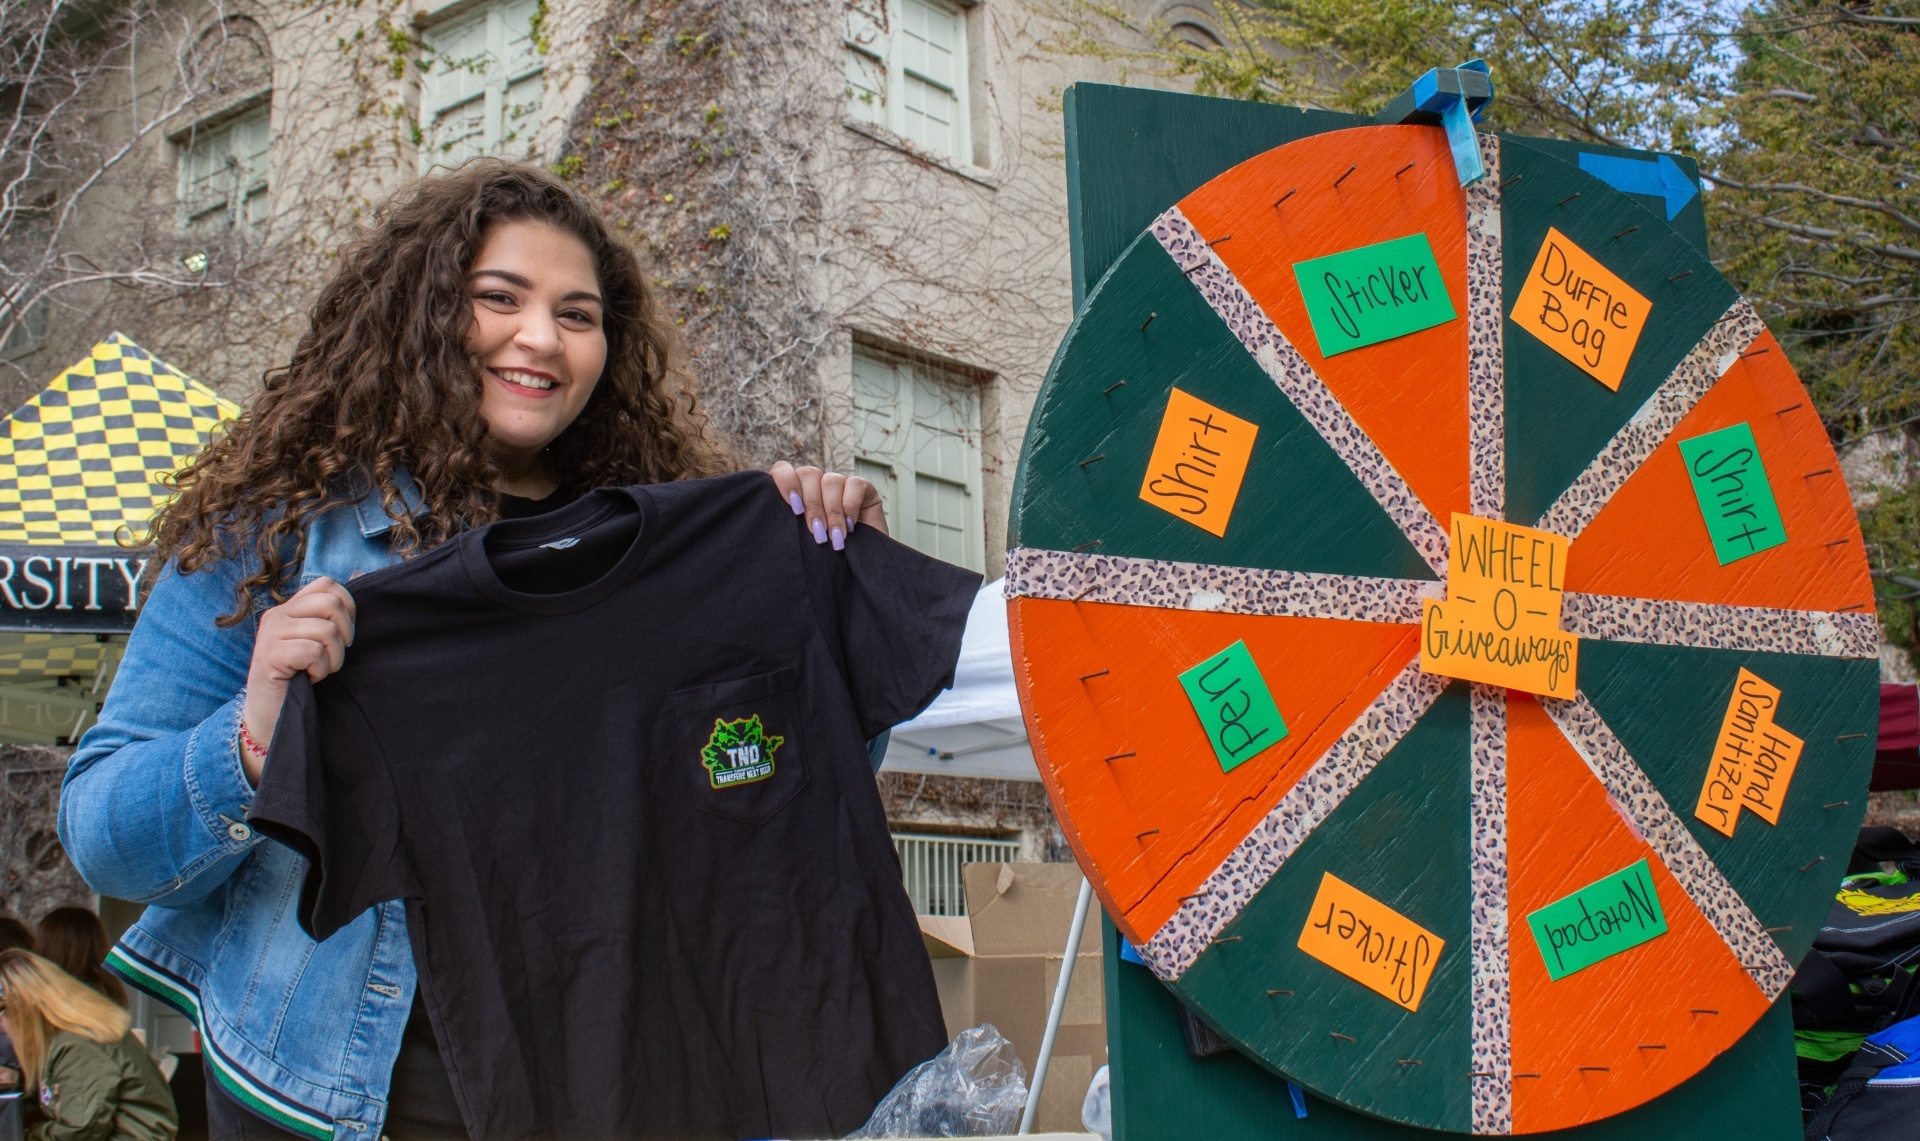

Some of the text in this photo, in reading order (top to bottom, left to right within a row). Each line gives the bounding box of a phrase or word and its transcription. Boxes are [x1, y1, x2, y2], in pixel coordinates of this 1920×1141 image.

[1539, 290, 1606, 368] Bag
[1149, 413, 1228, 515] Shirt
[1694, 447, 1768, 551] Shirt
[0, 555, 149, 611] RSITY
[1456, 520, 1562, 592] WHEEL
[1427, 604, 1573, 692] Giveaways
[1198, 656, 1270, 758] Pen
[727, 744, 759, 768] TND
[747, 769, 759, 779] NEXT
[1705, 680, 1774, 828] Sanitizer
[1742, 732, 1792, 811] Hand
[1314, 902, 1430, 1005] Sticker
[1544, 871, 1658, 972] Notepad
